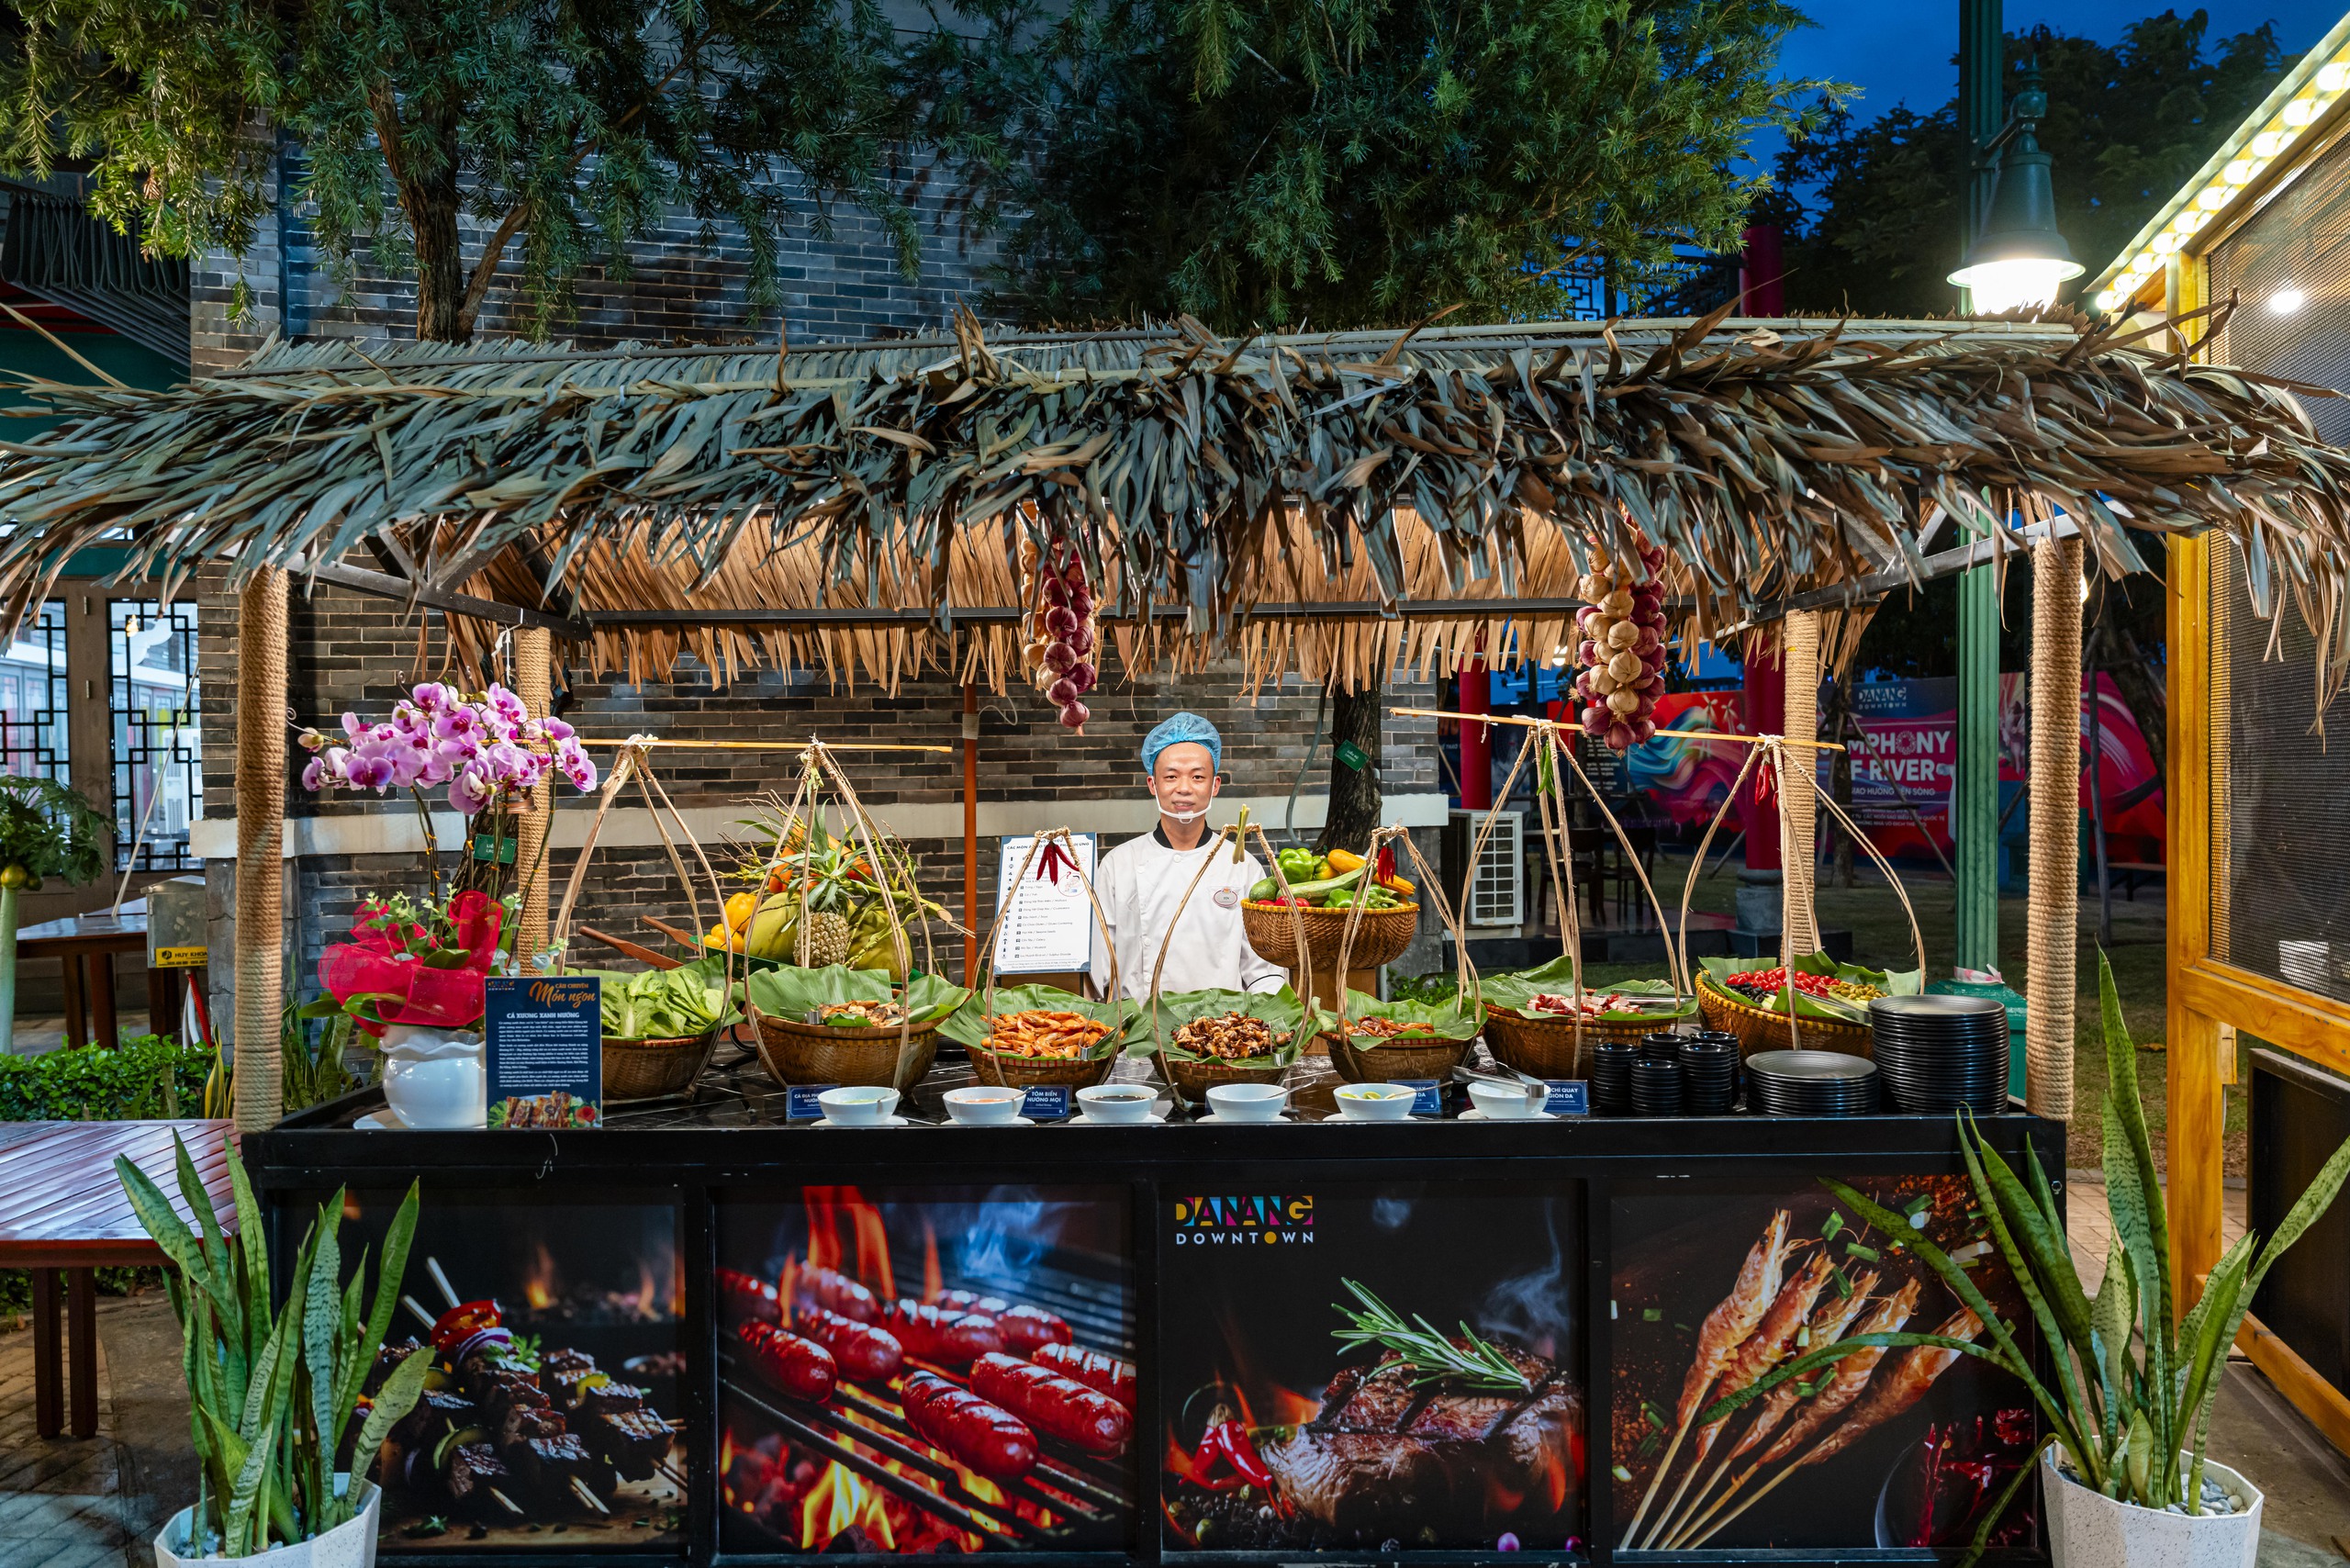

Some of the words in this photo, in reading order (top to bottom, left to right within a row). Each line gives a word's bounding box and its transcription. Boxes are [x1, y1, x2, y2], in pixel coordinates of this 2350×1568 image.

[1859, 687, 1907, 702] DANANG
[1851, 759, 1863, 781] F
[1869, 758, 1935, 781] RIVER
[529, 980, 565, 1008] Món
[568, 991, 596, 1008] ngon
[1176, 1195, 1313, 1226] DANANG
[1176, 1231, 1314, 1245] DOWNTOWN
